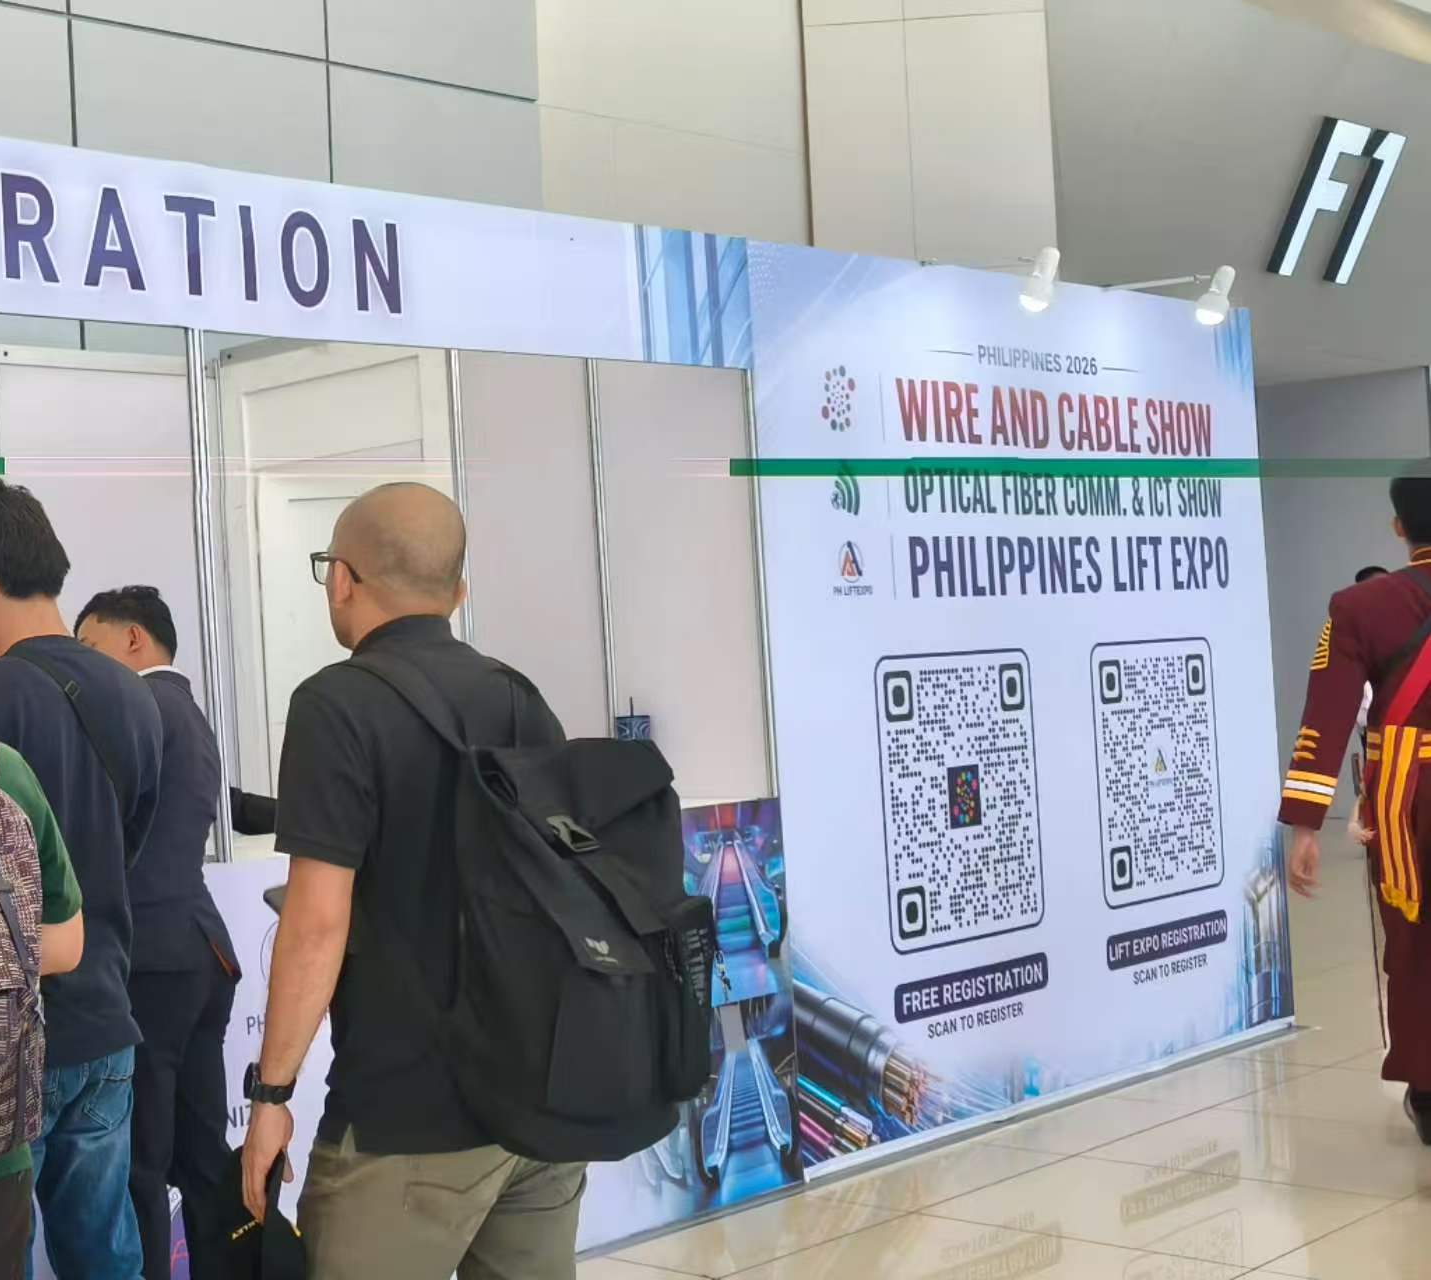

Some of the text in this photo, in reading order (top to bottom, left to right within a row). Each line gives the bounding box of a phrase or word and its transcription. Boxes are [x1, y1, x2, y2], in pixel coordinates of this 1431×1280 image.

[1268, 116, 1407, 285] F1
[977, 345, 1098, 376] PHILIPPINES 2026
[895, 377, 1211, 457] WIRE AND CABLE SHOW
[904, 467, 1221, 517] OPTICAL FIBER COMM. & ICT SHOW
[908, 535, 1230, 598] PHILIPPINES LIFT EXPO
[1109, 917, 1226, 962] LIFT EXPO REGISTRATION
[902, 961, 1044, 1015] FREE REGISTRATION
[1133, 953, 1208, 985] SCAN TO REGISTER
[927, 1002, 1024, 1039] SCAN TO REGISTER
